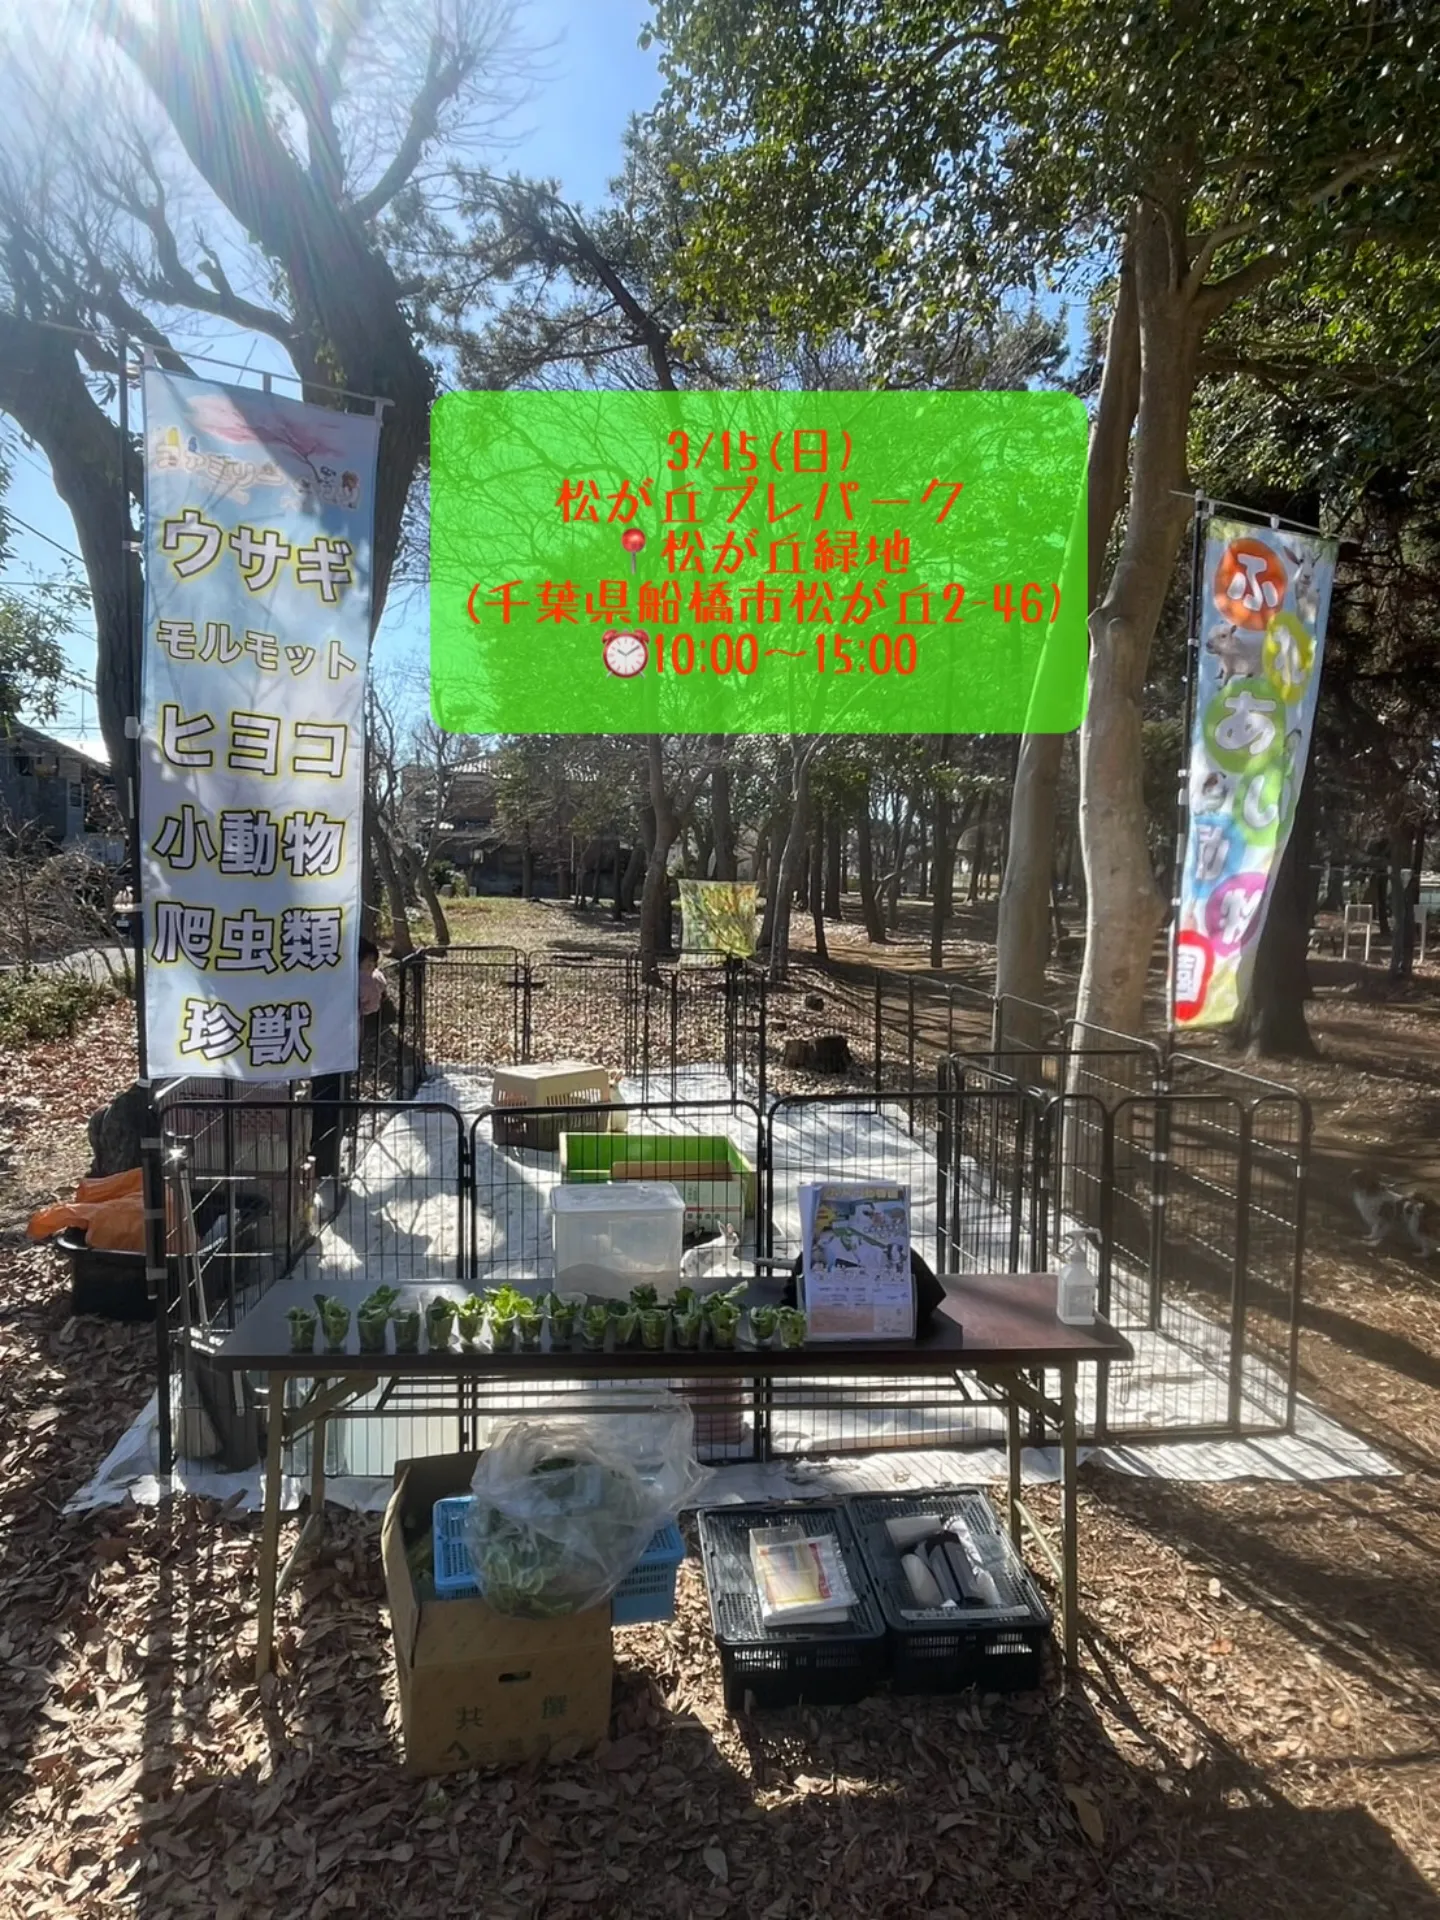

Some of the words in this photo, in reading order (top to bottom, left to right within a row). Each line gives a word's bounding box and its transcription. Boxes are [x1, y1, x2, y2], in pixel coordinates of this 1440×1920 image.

[162, 509, 352, 602] ウサギ
[156, 620, 356, 680] モルモット
[162, 704, 347, 777] ヒヨコ
[152, 805, 345, 877] 小動物
[152, 901, 342, 974] 爬虫類
[180, 997, 312, 1066] 珍獣
